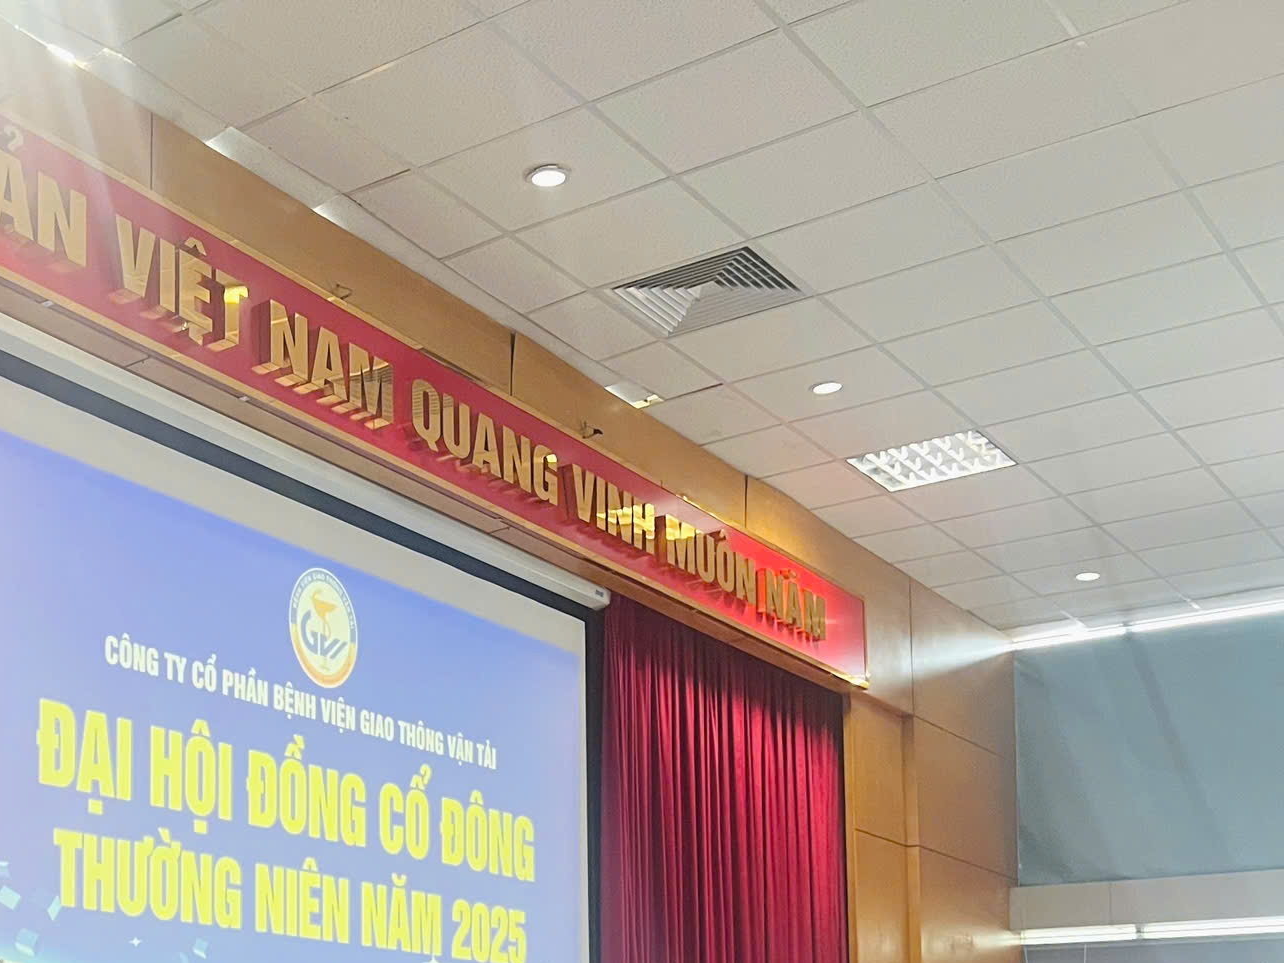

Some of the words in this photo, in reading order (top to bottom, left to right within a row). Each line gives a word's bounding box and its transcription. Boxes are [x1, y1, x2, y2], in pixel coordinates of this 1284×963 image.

[116, 213, 248, 346] VIỆT
[270, 299, 394, 426] NAM
[412, 378, 559, 506] QUANG
[572, 463, 655, 555] VINH
[665, 513, 756, 605] MUÔN
[766, 568, 826, 641] NĂM
[105, 632, 159, 677] CÔNG
[164, 651, 187, 684] TY
[191, 653, 217, 693] CỔ
[222, 667, 269, 707] PHẦN
[273, 681, 317, 720] BỆNH
[320, 696, 356, 733] VIỆN
[360, 708, 395, 741] GIAO
[398, 720, 444, 755] THÔNG
[447, 732, 473, 766] VẬN
[36, 698, 133, 815] ĐẠI
[150, 718, 233, 835] HỘI
[246, 734, 367, 848] ĐỒNG
[379, 764, 432, 860] CỔ
[440, 789, 535, 882] ĐÔNG
[53, 827, 242, 930] THƯỜNG
[255, 857, 350, 944] NIÊN
[361, 872, 442, 957] NĂM
